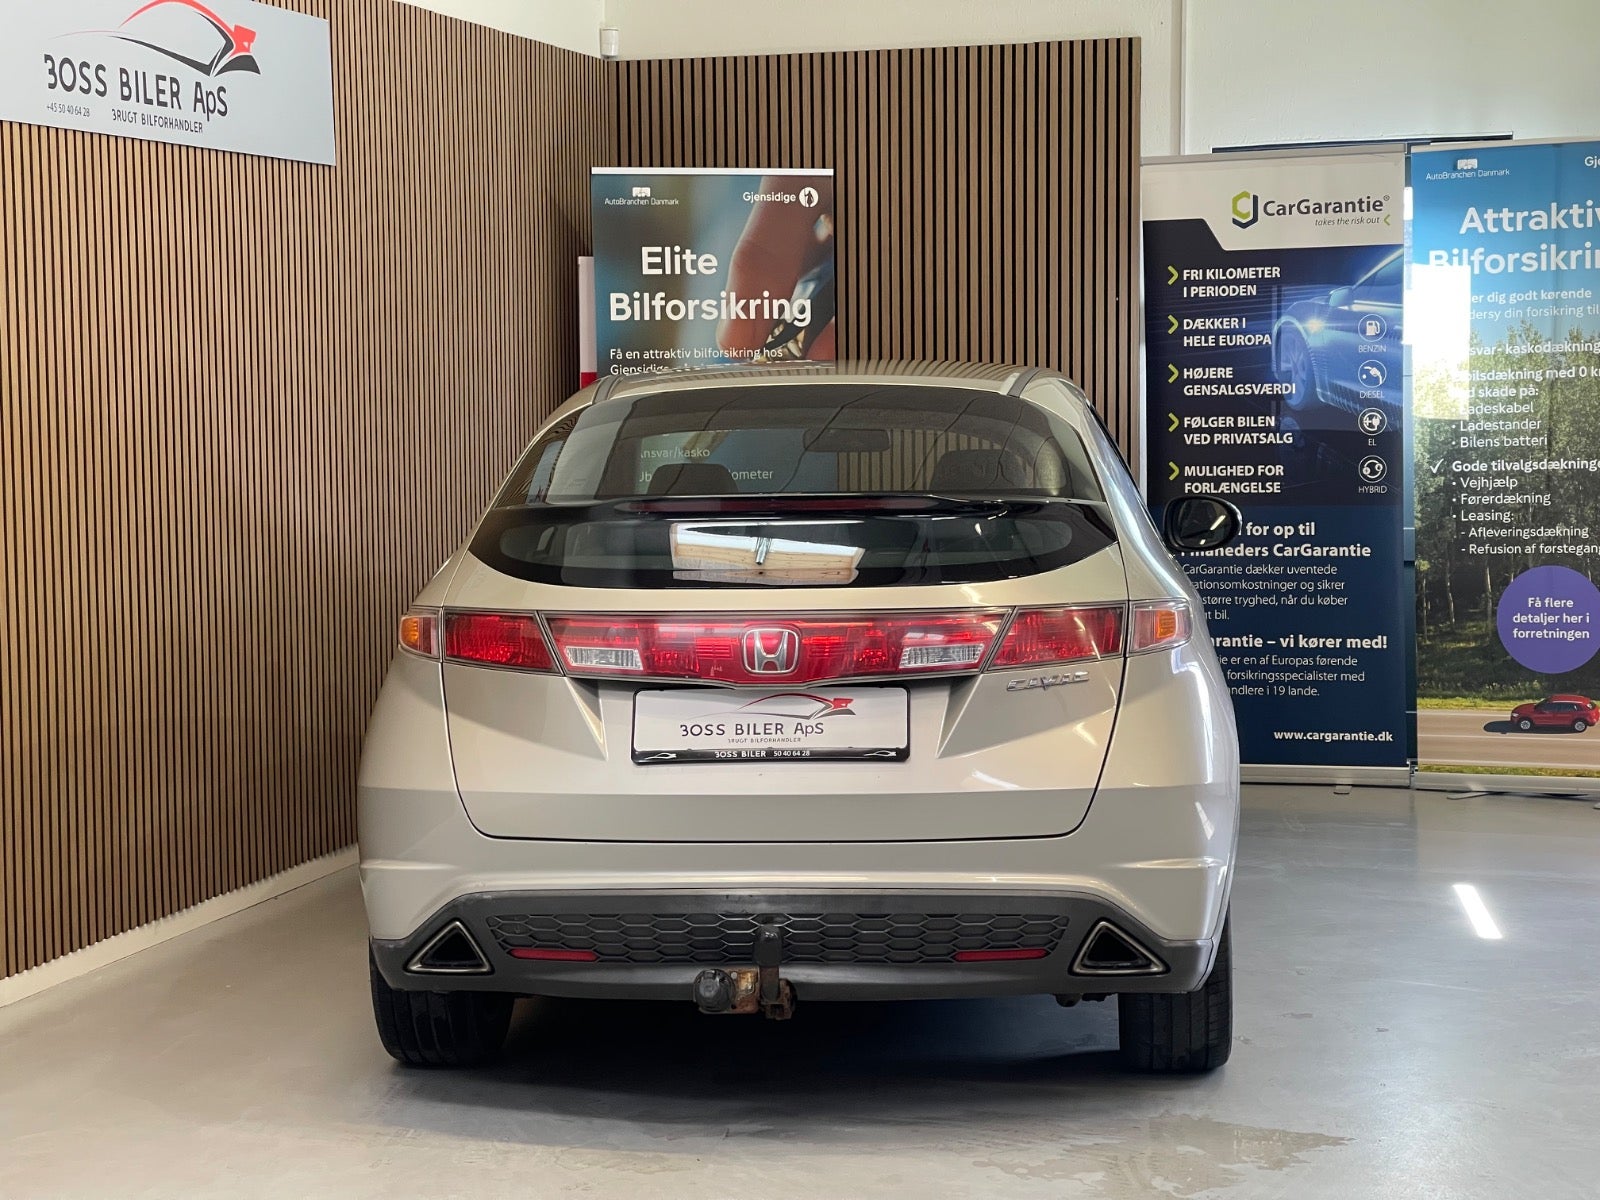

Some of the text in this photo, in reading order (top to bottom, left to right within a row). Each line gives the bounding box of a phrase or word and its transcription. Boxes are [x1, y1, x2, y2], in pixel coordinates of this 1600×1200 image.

[119, 67, 182, 110] BILER
[193, 81, 228, 121] ApS
[141, 114, 203, 133] BILFORHANDLER
[1426, 169, 1510, 180] AutoBranchen Danmark
[604, 197, 679, 206] AutoBranchen Danmark
[743, 191, 796, 205] Gjensidige
[1315, 217, 1380, 227] takes the risk out
[642, 245, 718, 275] Elite
[1429, 241, 1600, 275] Bilforsikri
[1183, 267, 1281, 281] FRI KILOMETER
[1183, 284, 1257, 298] I PERIODEN
[1487, 291, 1506, 304] dig
[1509, 290, 1538, 304] godt
[1541, 288, 1592, 300] kørende
[610, 291, 812, 327] Bilforsikring
[1504, 308, 1522, 318] din
[1527, 305, 1583, 318] forsikring
[1587, 304, 1599, 315] til
[1183, 317, 1246, 330] DÆKKER I
[1183, 334, 1272, 347] HELE EUROPA
[610, 347, 782, 360] Få en attraktiv bilforsikring hos
[1469, 345, 1502, 355] svar-
[1184, 367, 1233, 379] HØJERE
[1546, 366, 1575, 378] med
[1579, 366, 1587, 377] 0
[1184, 383, 1296, 396] GENSALGSVÆRDI
[1478, 386, 1516, 398] skade
[1519, 384, 1538, 400] på:
[1184, 416, 1275, 428] FØLGER BILEN
[1460, 418, 1541, 432] Ladestander
[1184, 432, 1293, 445] VED PRIVATSALG
[1460, 434, 1548, 448] Bilens batteri
[1184, 465, 1284, 477] MULIGHED FOR
[1452, 460, 1488, 472] Gode
[729, 470, 774, 480] ometer
[1184, 481, 1281, 494] FORLÆNGELSE
[1460, 476, 1518, 490] Vejhjælp
[1359, 486, 1387, 494] HYBRID
[1461, 492, 1551, 506] Førerdækning
[1461, 510, 1514, 523] Leasing:
[1246, 522, 1316, 539] for op til
[1469, 526, 1589, 539] Afleveringsdækning
[1273, 543, 1371, 557] CarGarantie
[1469, 544, 1521, 554] Refusion
[1525, 543, 1536, 554] af
[1182, 563, 1338, 575] CarGarantie dækker uventede
[1300, 581, 1314, 592] og
[1317, 579, 1345, 590] sikrer
[1203, 594, 1348, 607] større tryghed, når du køber
[1528, 597, 1574, 608] Få flere
[1215, 609, 1230, 620] bil.
[1513, 613, 1590, 626] detaljer her i
[1513, 628, 1590, 641] forretningen
[1280, 634, 1294, 648] vi
[1299, 634, 1342, 648] kører
[1346, 635, 1388, 649] med!
[1231, 657, 1242, 665] er
[1243, 657, 1257, 666] en
[1259, 655, 1271, 665] af
[1272, 655, 1314, 668] Europas
[1316, 655, 1358, 666] førende
[1227, 669, 1365, 683] forsikringsspecialister med
[1228, 686, 1264, 696] ndlere
[1273, 686, 1286, 696] 19
[1288, 686, 1320, 696] lande.
[735, 723, 784, 736] BILER
[794, 722, 824, 737] ApS
[1274, 731, 1394, 743] www.cargarantie.dk
[741, 750, 766, 758] BILER
